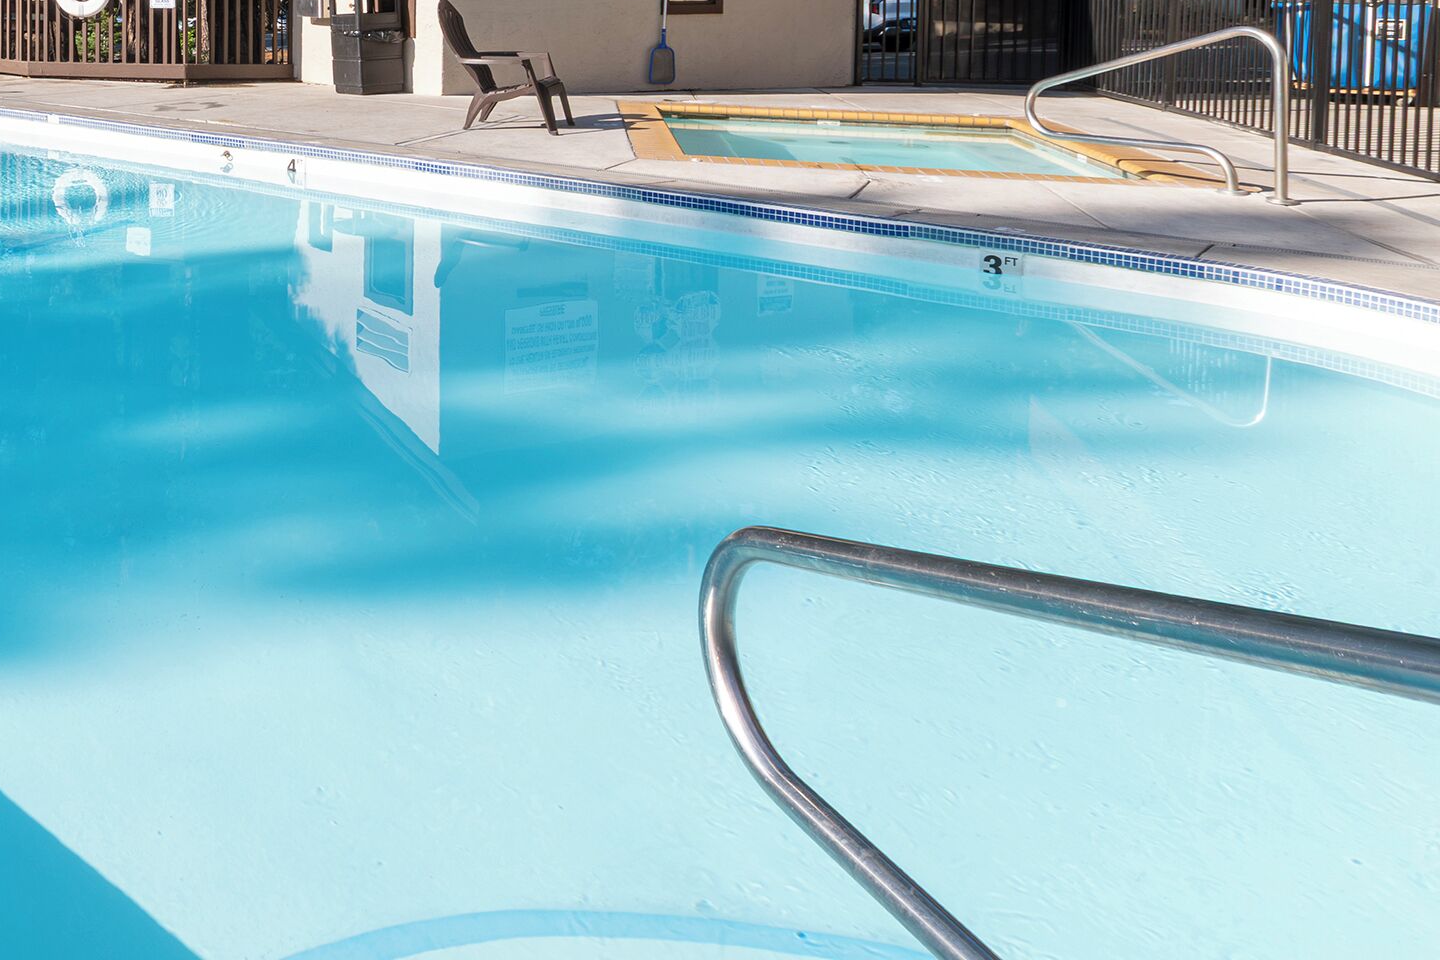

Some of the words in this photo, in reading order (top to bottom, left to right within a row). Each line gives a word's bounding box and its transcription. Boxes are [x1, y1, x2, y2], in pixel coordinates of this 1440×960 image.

[287, 159, 296, 172] 4
[983, 255, 1002, 274] 3
[1005, 257, 1018, 266] FT
